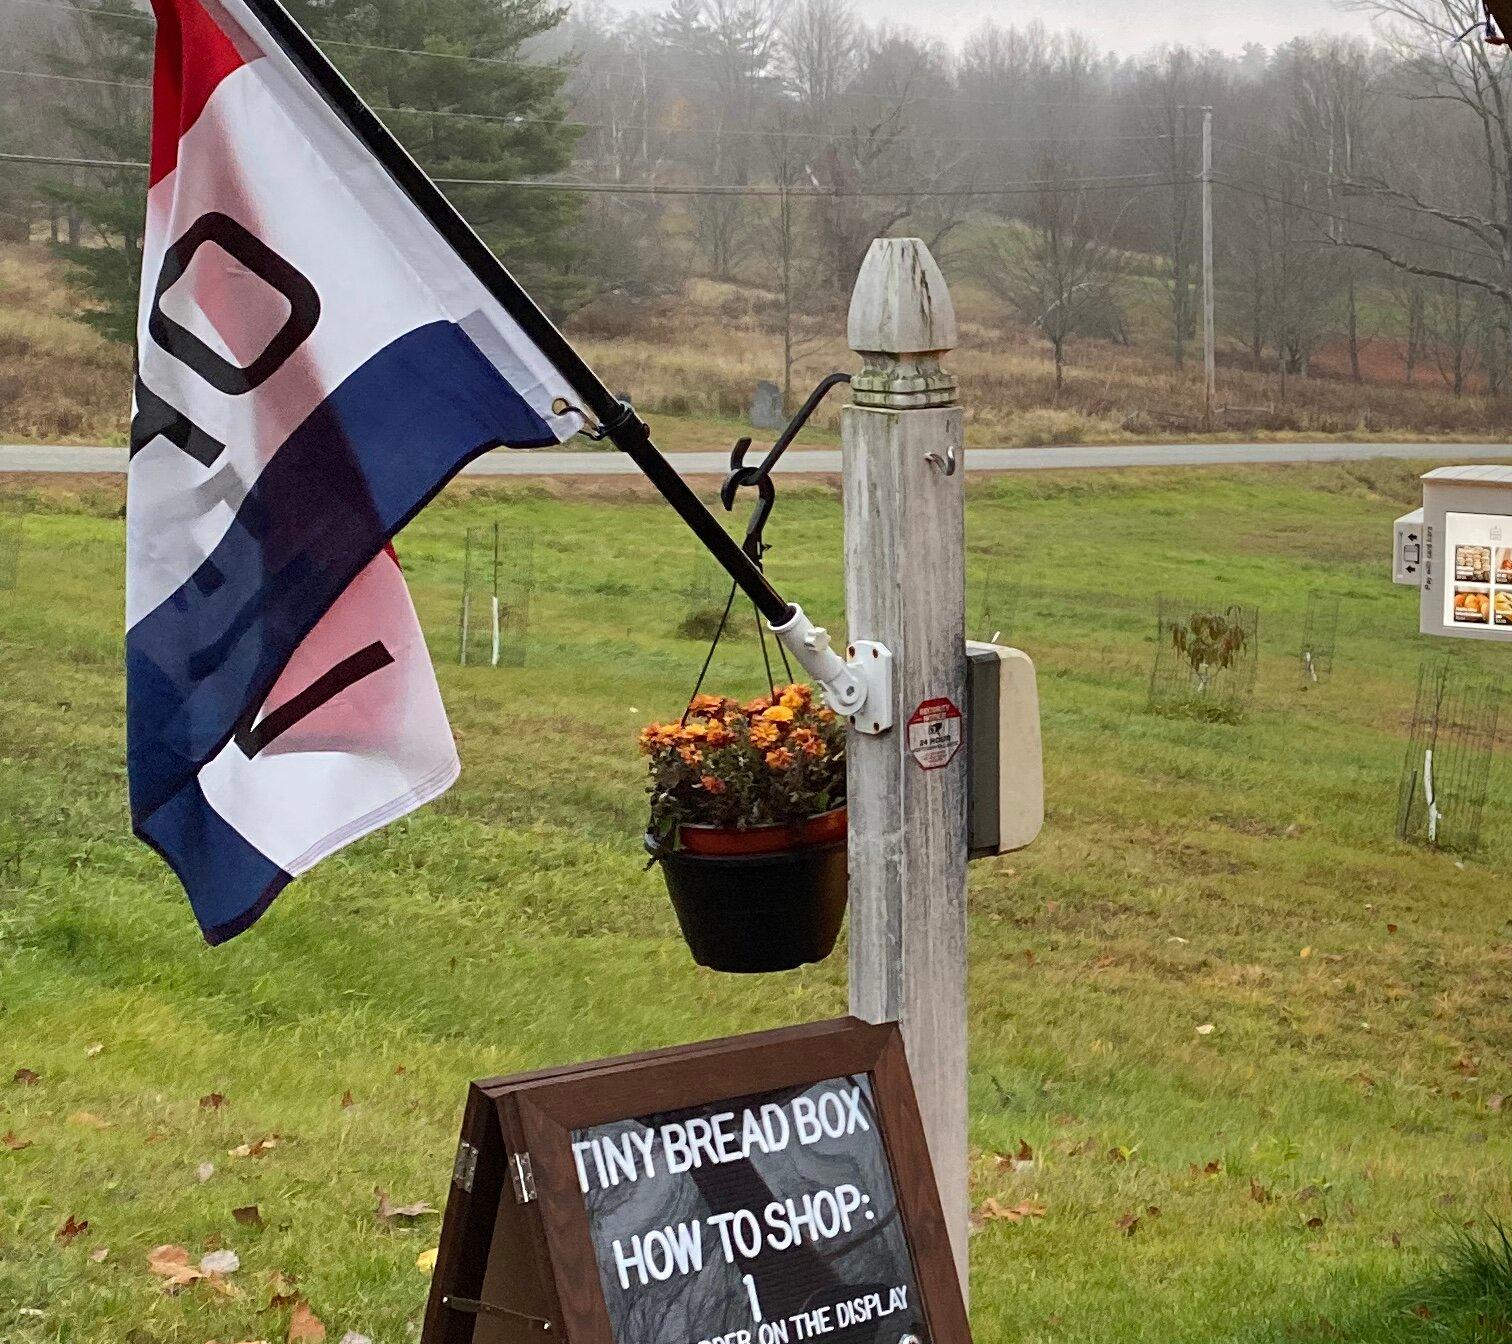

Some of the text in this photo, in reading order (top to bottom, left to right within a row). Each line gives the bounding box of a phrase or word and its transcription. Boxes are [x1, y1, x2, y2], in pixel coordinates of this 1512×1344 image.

[571, 1085, 870, 1193] TINY BREAD BOX
[611, 1184, 875, 1289] HOW TO SHOP:
[742, 1273, 763, 1323] 1
[788, 1306, 835, 1340] THE
[836, 1284, 908, 1329] DISPLAY
